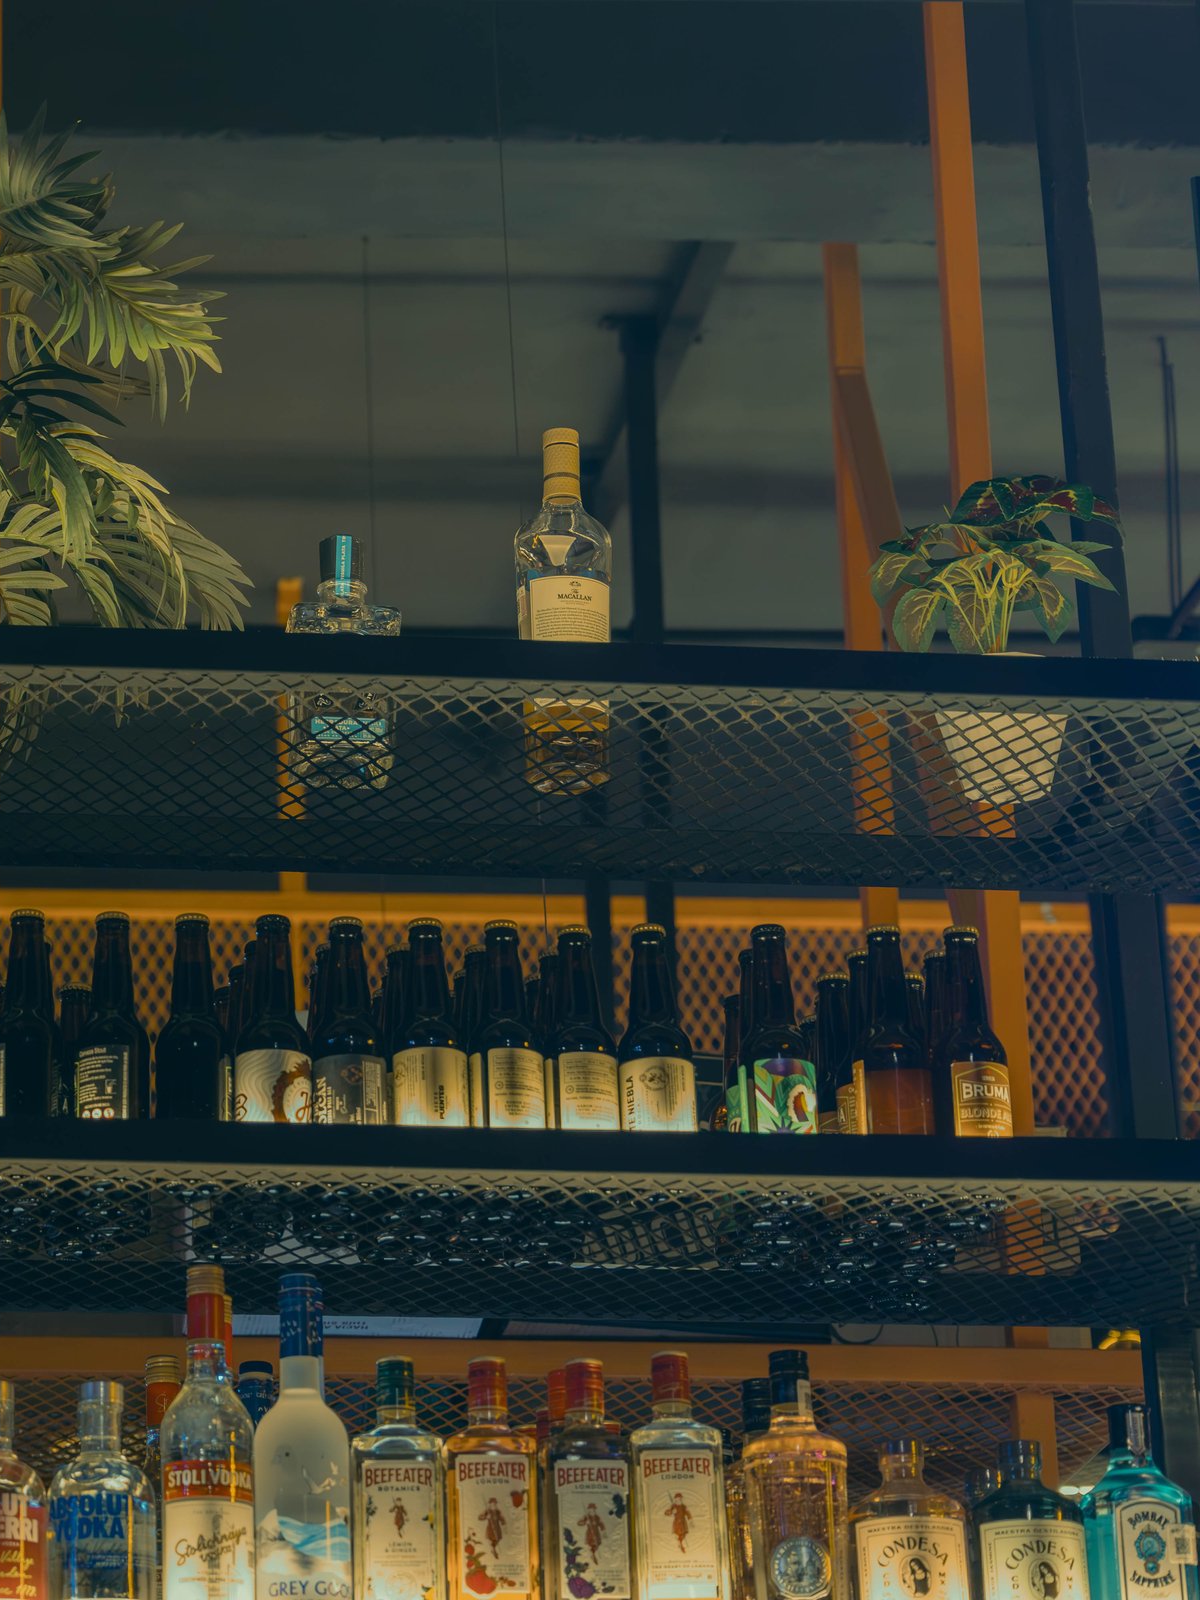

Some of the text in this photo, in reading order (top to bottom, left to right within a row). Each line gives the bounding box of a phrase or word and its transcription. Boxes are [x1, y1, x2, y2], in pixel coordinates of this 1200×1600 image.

[557, 593, 592, 602] MACALLAN
[625, 1075, 635, 1115] NIEBLA
[962, 1082, 1010, 1103] BRUMA
[960, 1106, 1002, 1120] BLONDE
[365, 1467, 433, 1488] BEEFEATER
[458, 1462, 526, 1482] BEEFEATER
[557, 1467, 625, 1488] BEEFEATER
[643, 1458, 711, 1479] BEEFEATER
[168, 1469, 252, 1490] STOLI VODKA
[49, 1492, 128, 1519] ABSOLUT
[53, 1516, 125, 1542] VODKA
[1127, 1511, 1170, 1530] BOMBAY
[877, 1536, 949, 1568] CONDESA
[1005, 1540, 1075, 1571] CONDESA
[268, 1580, 309, 1597] GREY
[1129, 1569, 1177, 1588] SAPPHIRE
